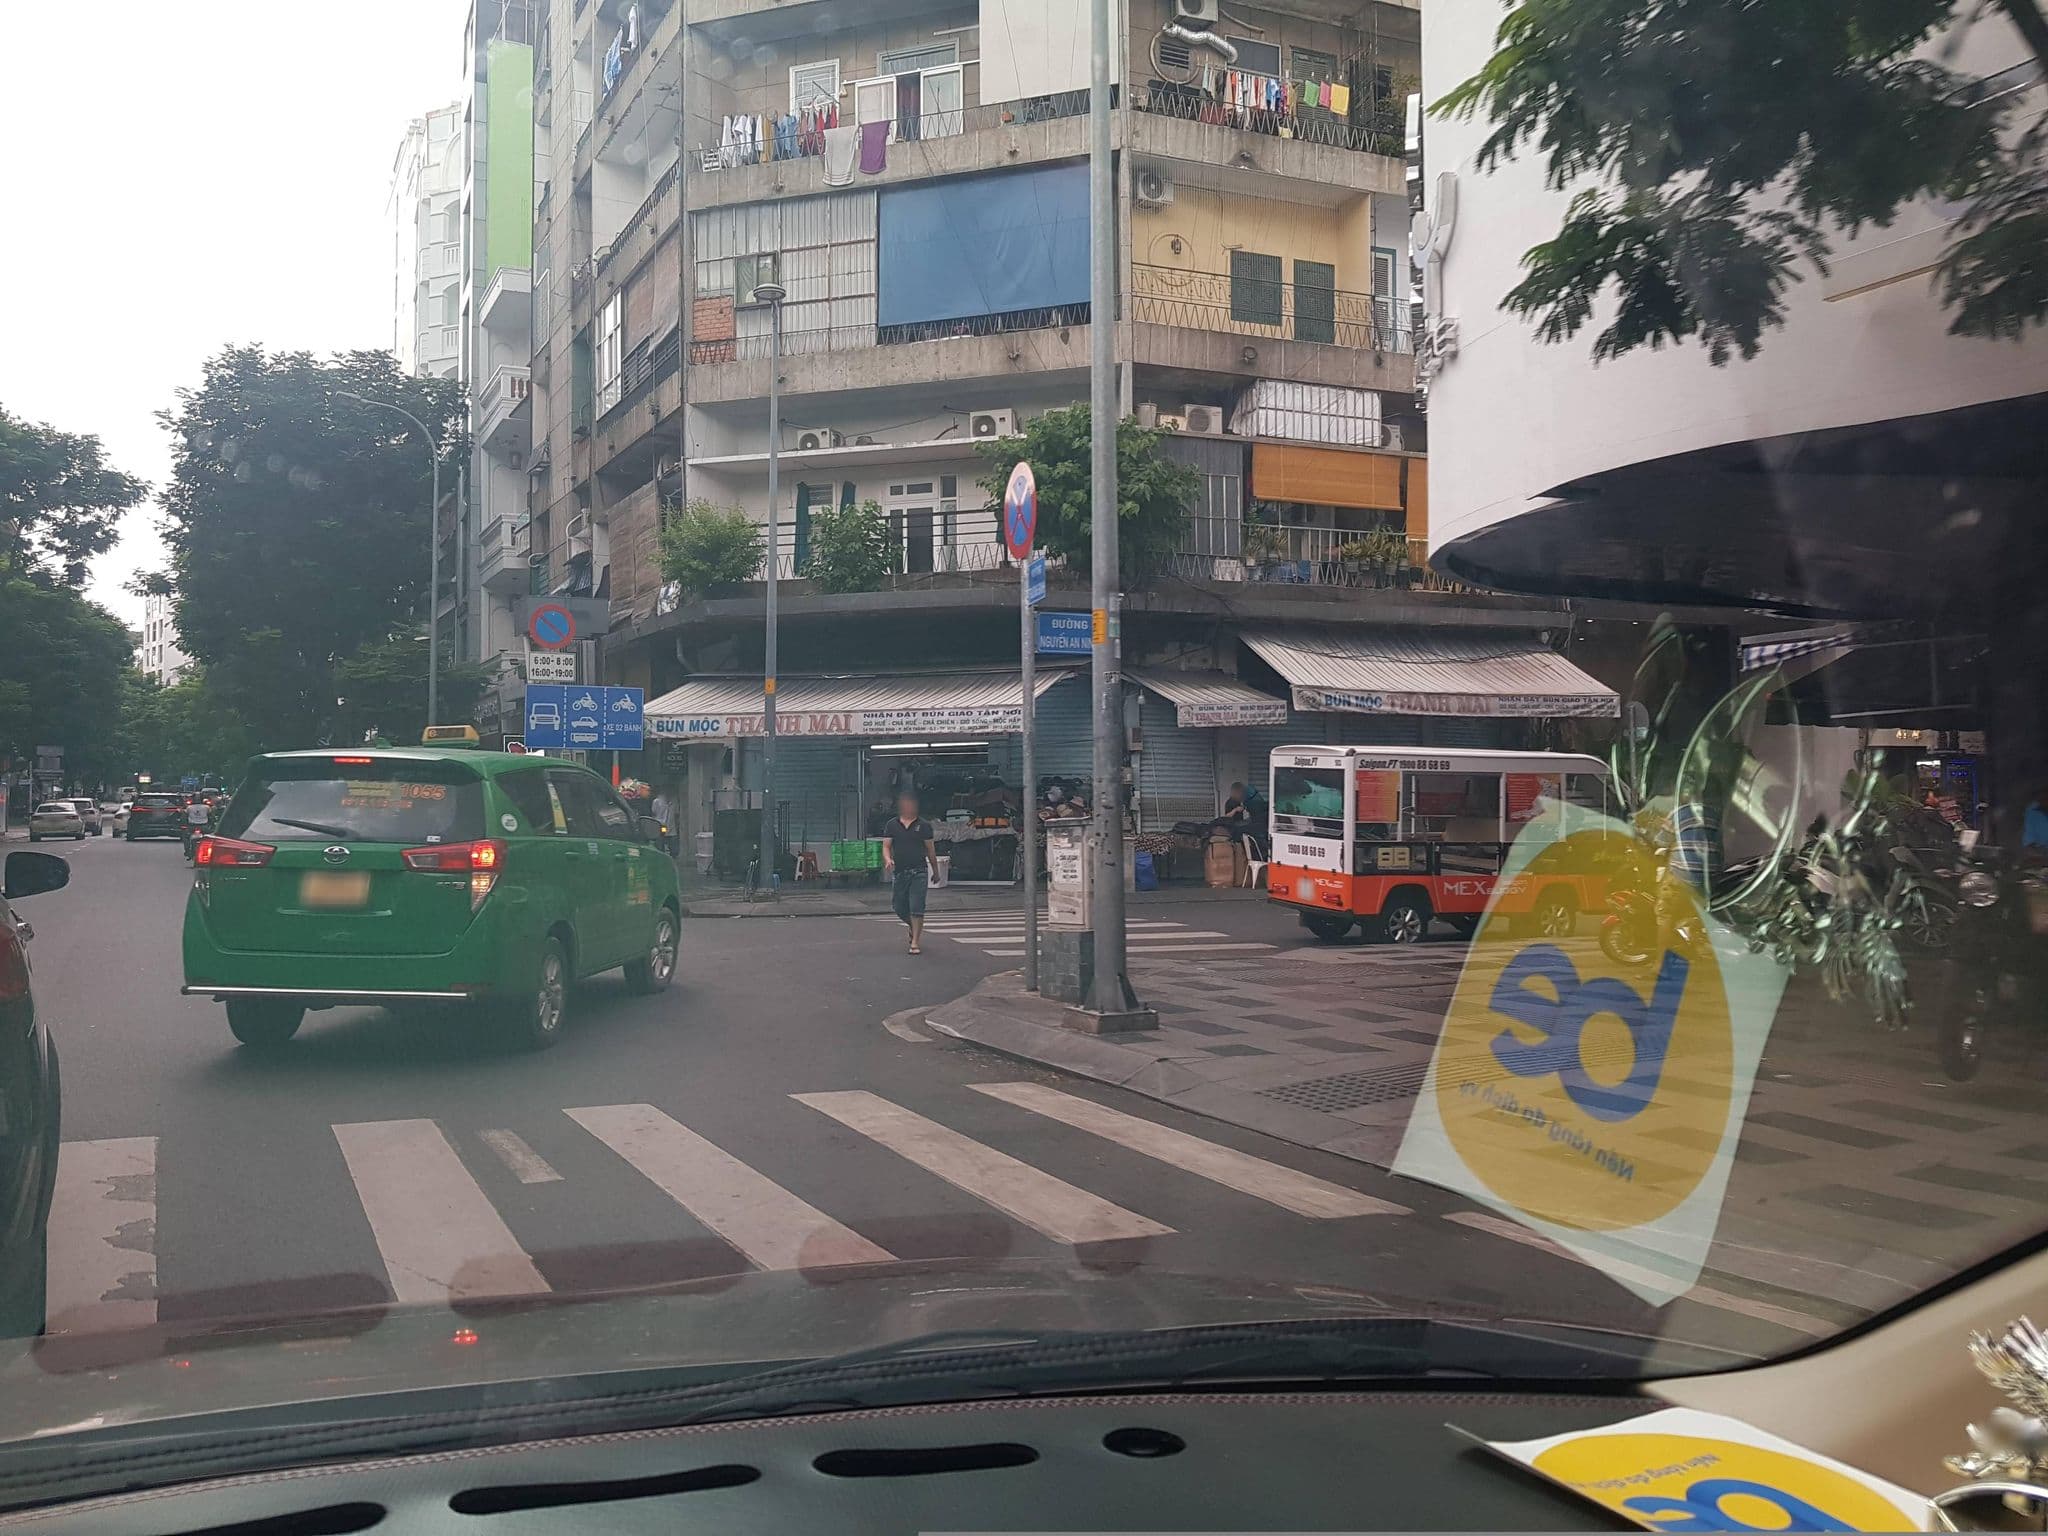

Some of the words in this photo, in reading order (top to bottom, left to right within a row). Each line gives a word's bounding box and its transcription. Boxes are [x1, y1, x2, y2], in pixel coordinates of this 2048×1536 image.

[1052, 617, 1089, 630] ĐƯỜNG
[1069, 636, 1080, 648] AN
[606, 723, 615, 731] XE
[808, 714, 853, 735] MAI
[1359, 758, 1398, 770] Saigon.PT
[400, 784, 446, 800] 1055
[1443, 880, 1487, 896] MEX
